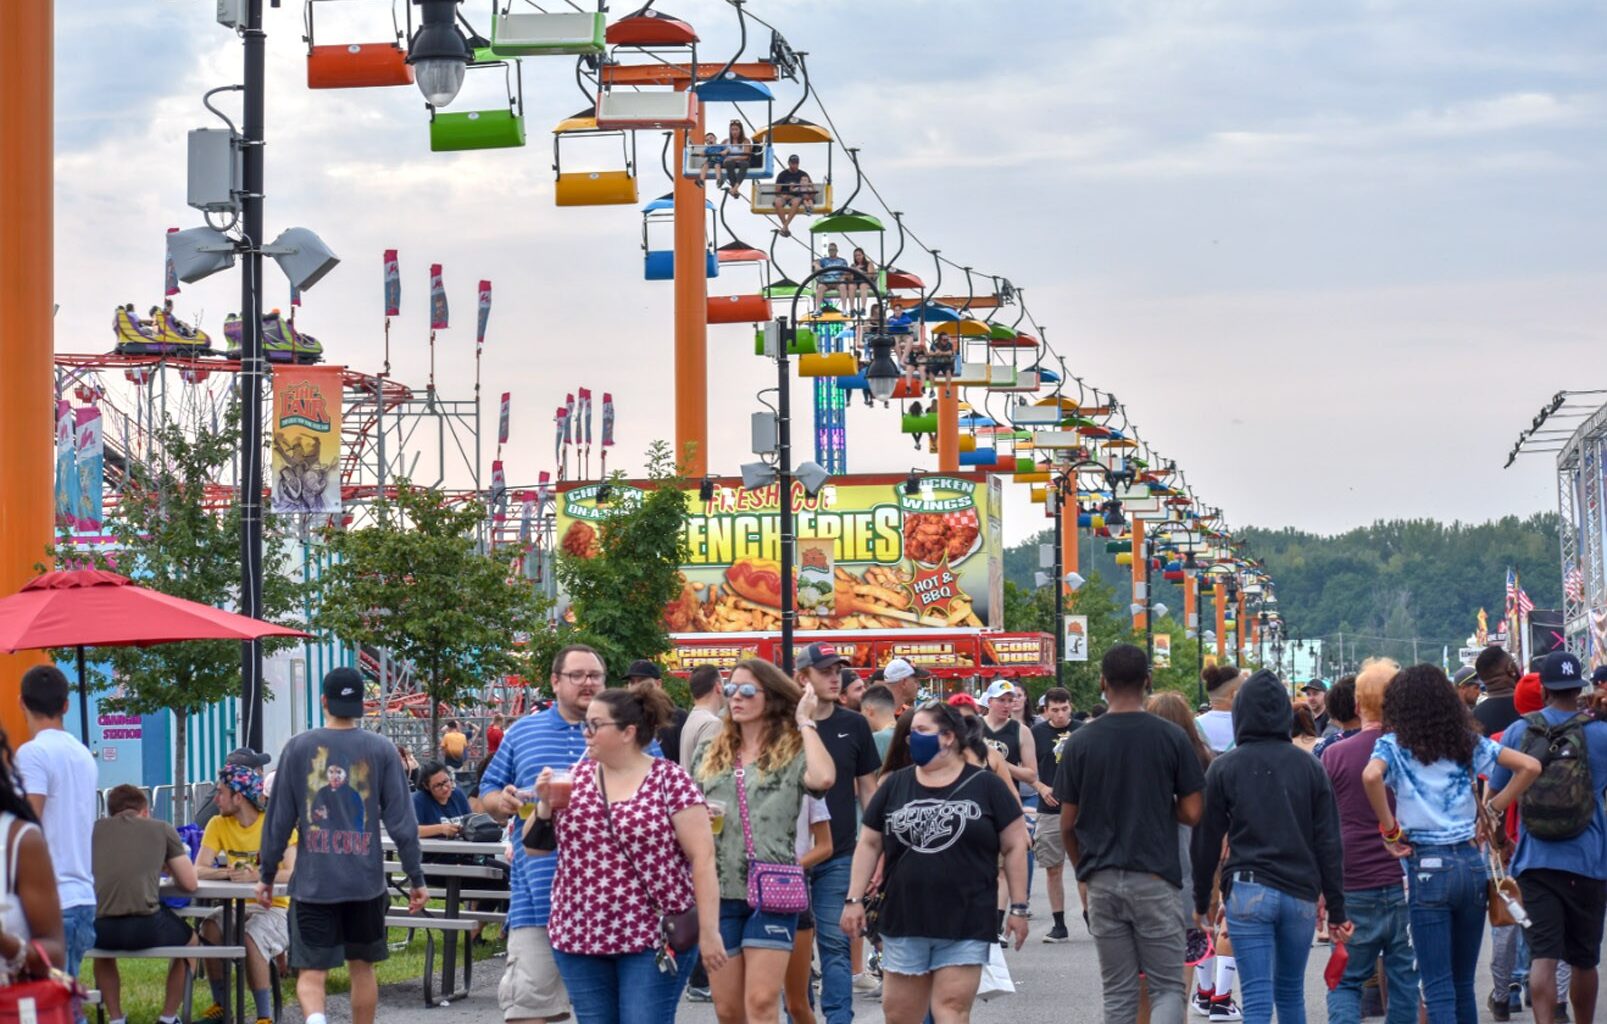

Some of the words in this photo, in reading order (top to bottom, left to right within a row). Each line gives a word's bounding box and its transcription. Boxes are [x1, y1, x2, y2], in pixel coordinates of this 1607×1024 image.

[706, 481, 781, 516] FRESH
[902, 495, 973, 511] WINGS
[913, 575, 939, 593] HOT
[942, 572, 953, 584] &
[921, 586, 952, 605] BBQ
[678, 648, 740, 658] CHEESE
[894, 644, 953, 654] CHILI
[995, 642, 1040, 652] CORN
[999, 652, 1040, 662] DOGS
[305, 829, 330, 853] ICE
[332, 830, 373, 855] CUBE
